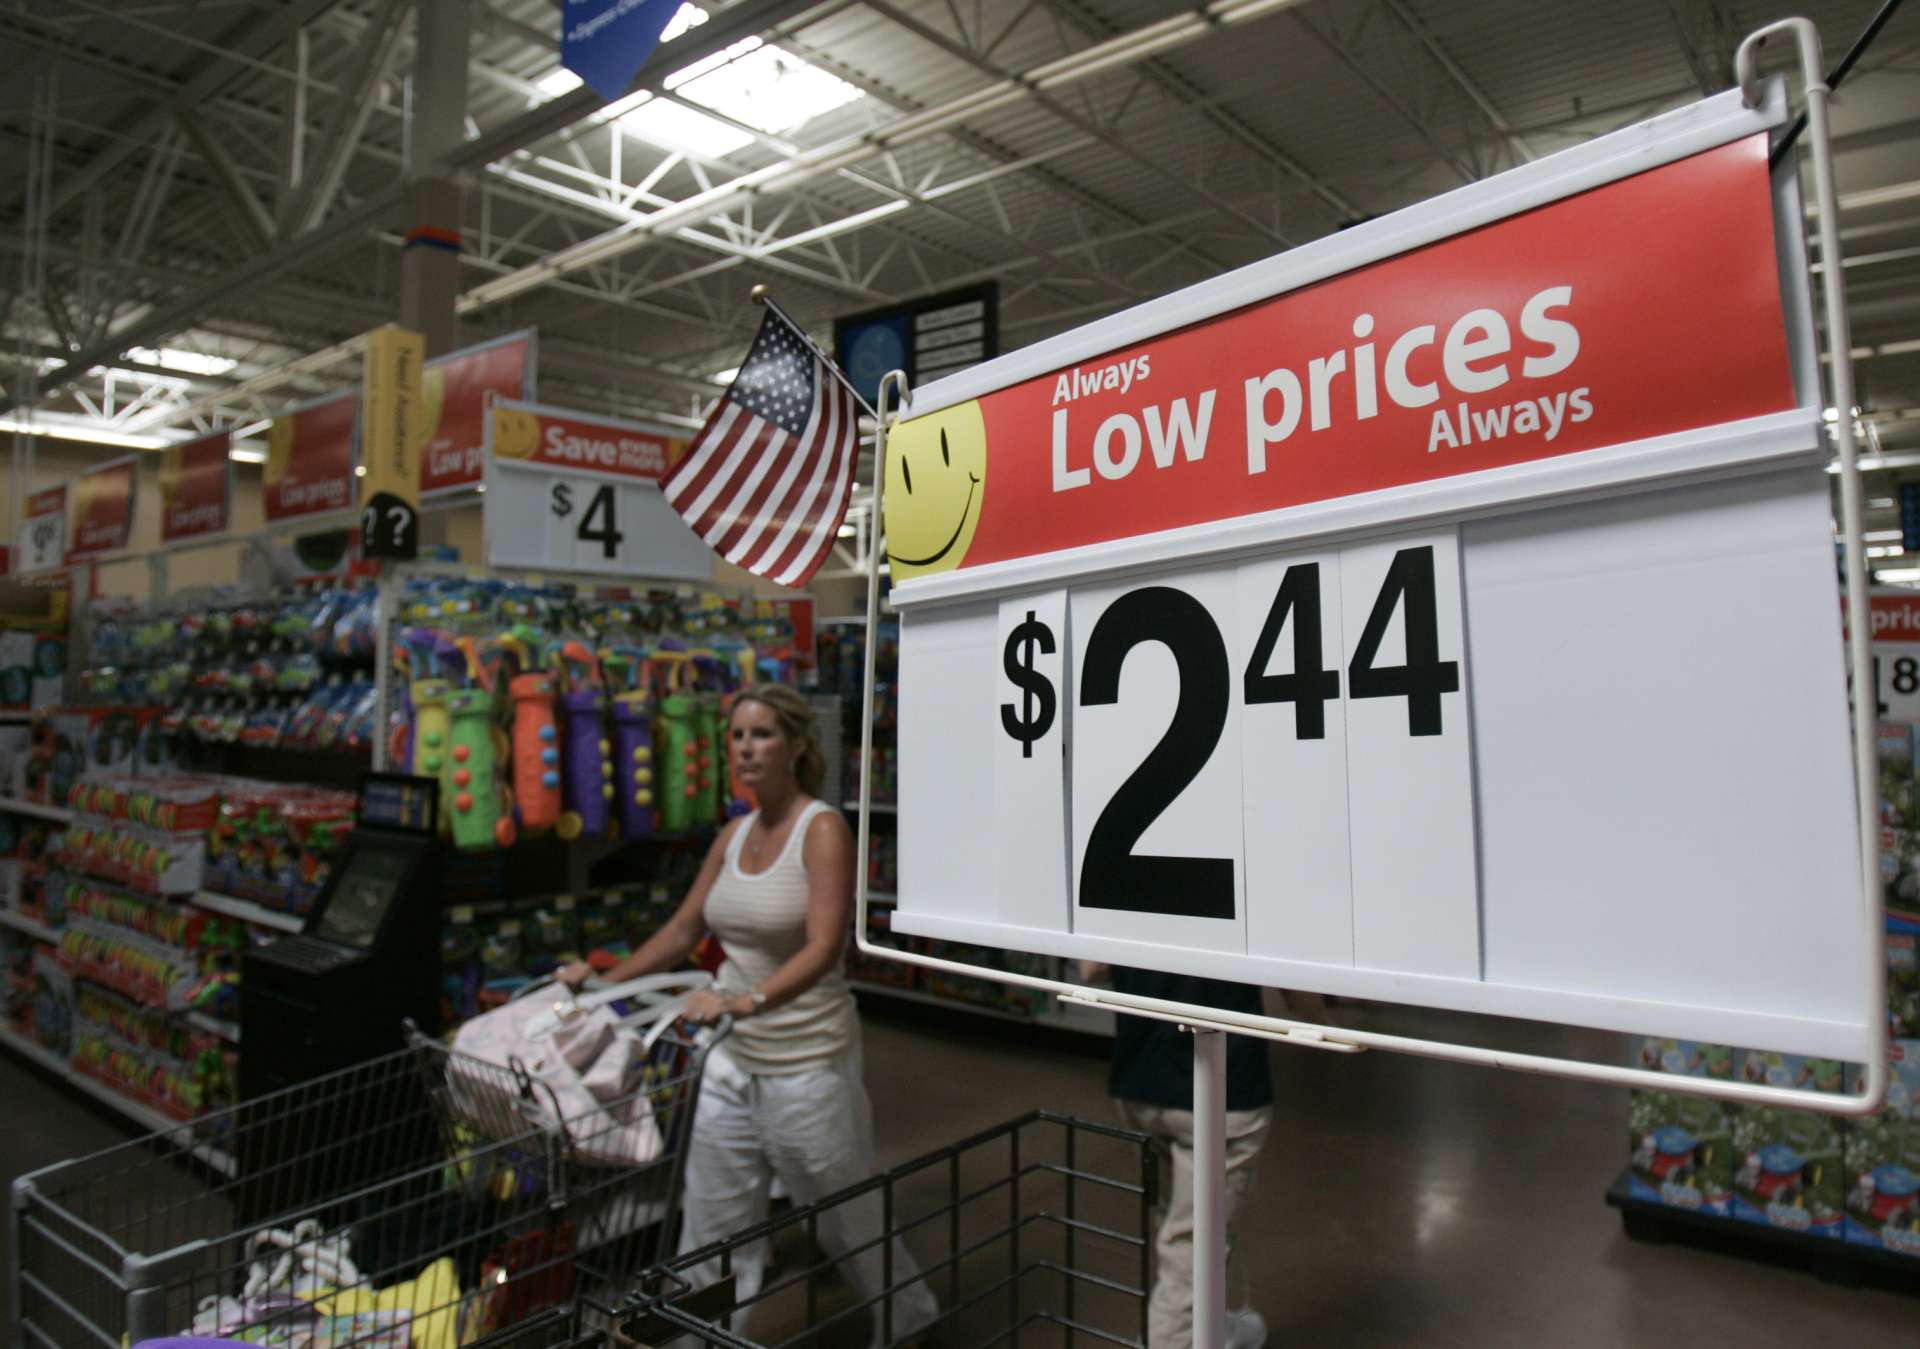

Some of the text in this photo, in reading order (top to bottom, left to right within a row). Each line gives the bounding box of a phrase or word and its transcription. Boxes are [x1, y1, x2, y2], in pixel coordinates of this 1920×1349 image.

[1051, 285, 1581, 493] Low prices
[1052, 354, 1152, 406] Always
[545, 426, 618, 465] Save
[1427, 386, 1594, 453] Always
